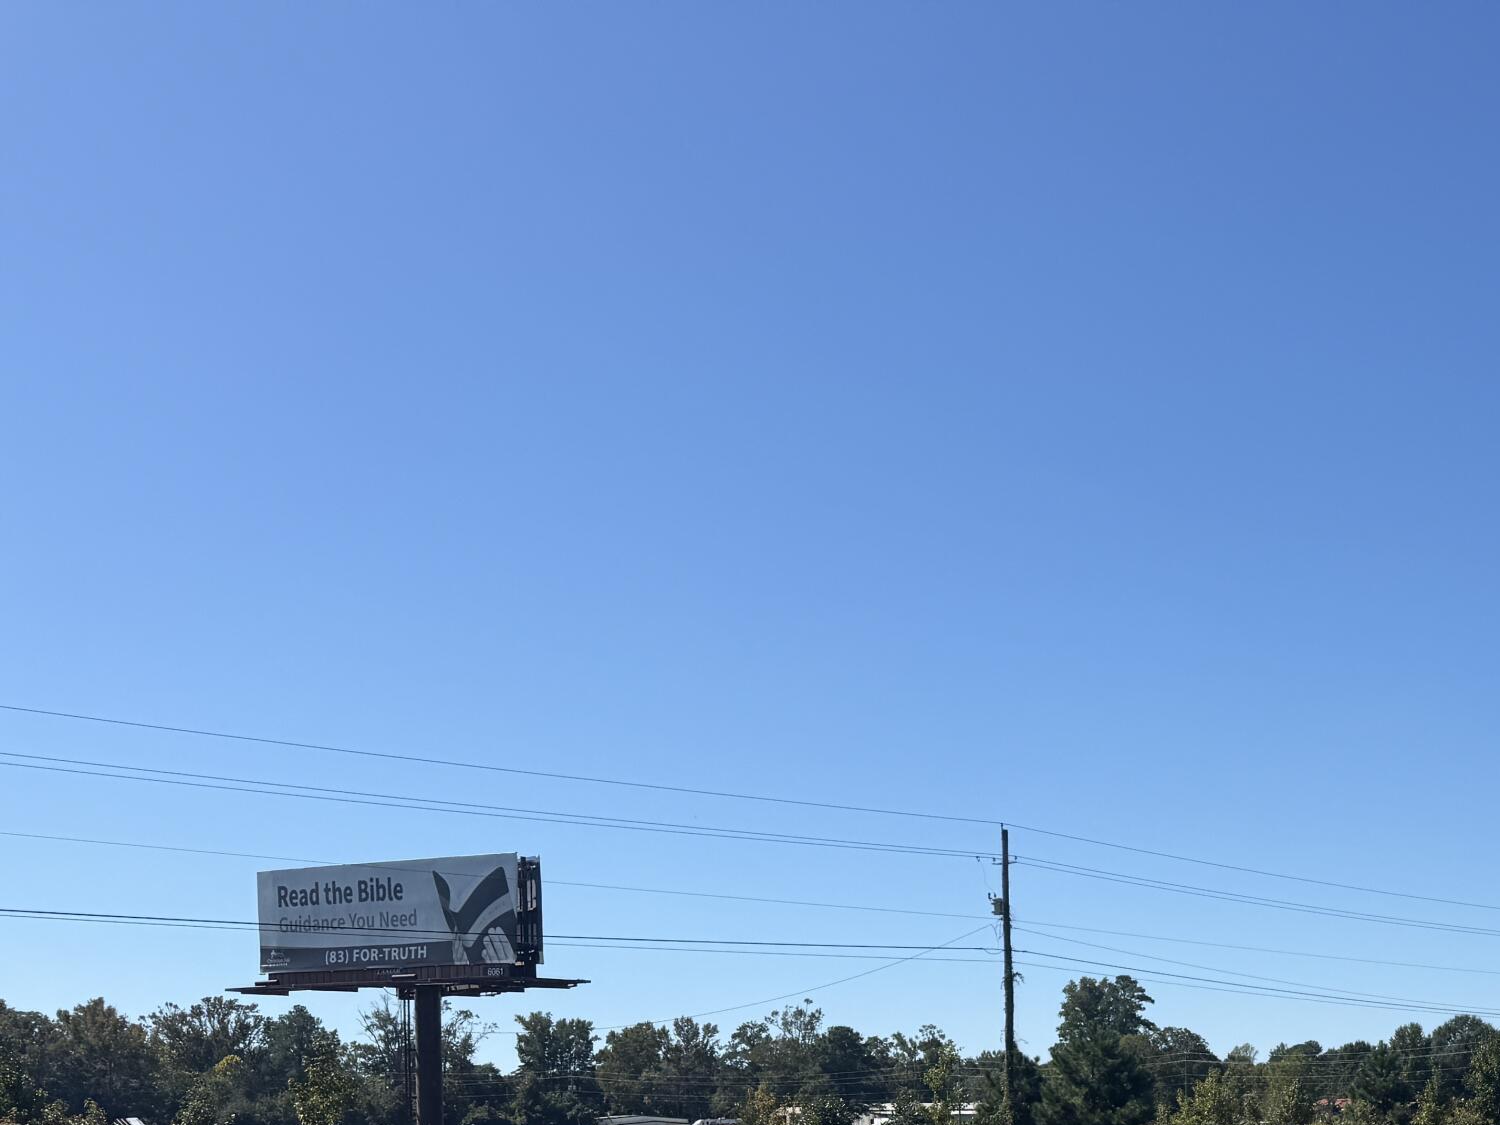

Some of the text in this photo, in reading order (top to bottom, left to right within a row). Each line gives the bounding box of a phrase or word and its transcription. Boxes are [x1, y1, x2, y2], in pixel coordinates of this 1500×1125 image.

[278, 877, 403, 908] Read the Bible
[280, 908, 417, 933] Guidance You Need
[325, 946, 427, 965] (83) FOR-TRUTH
